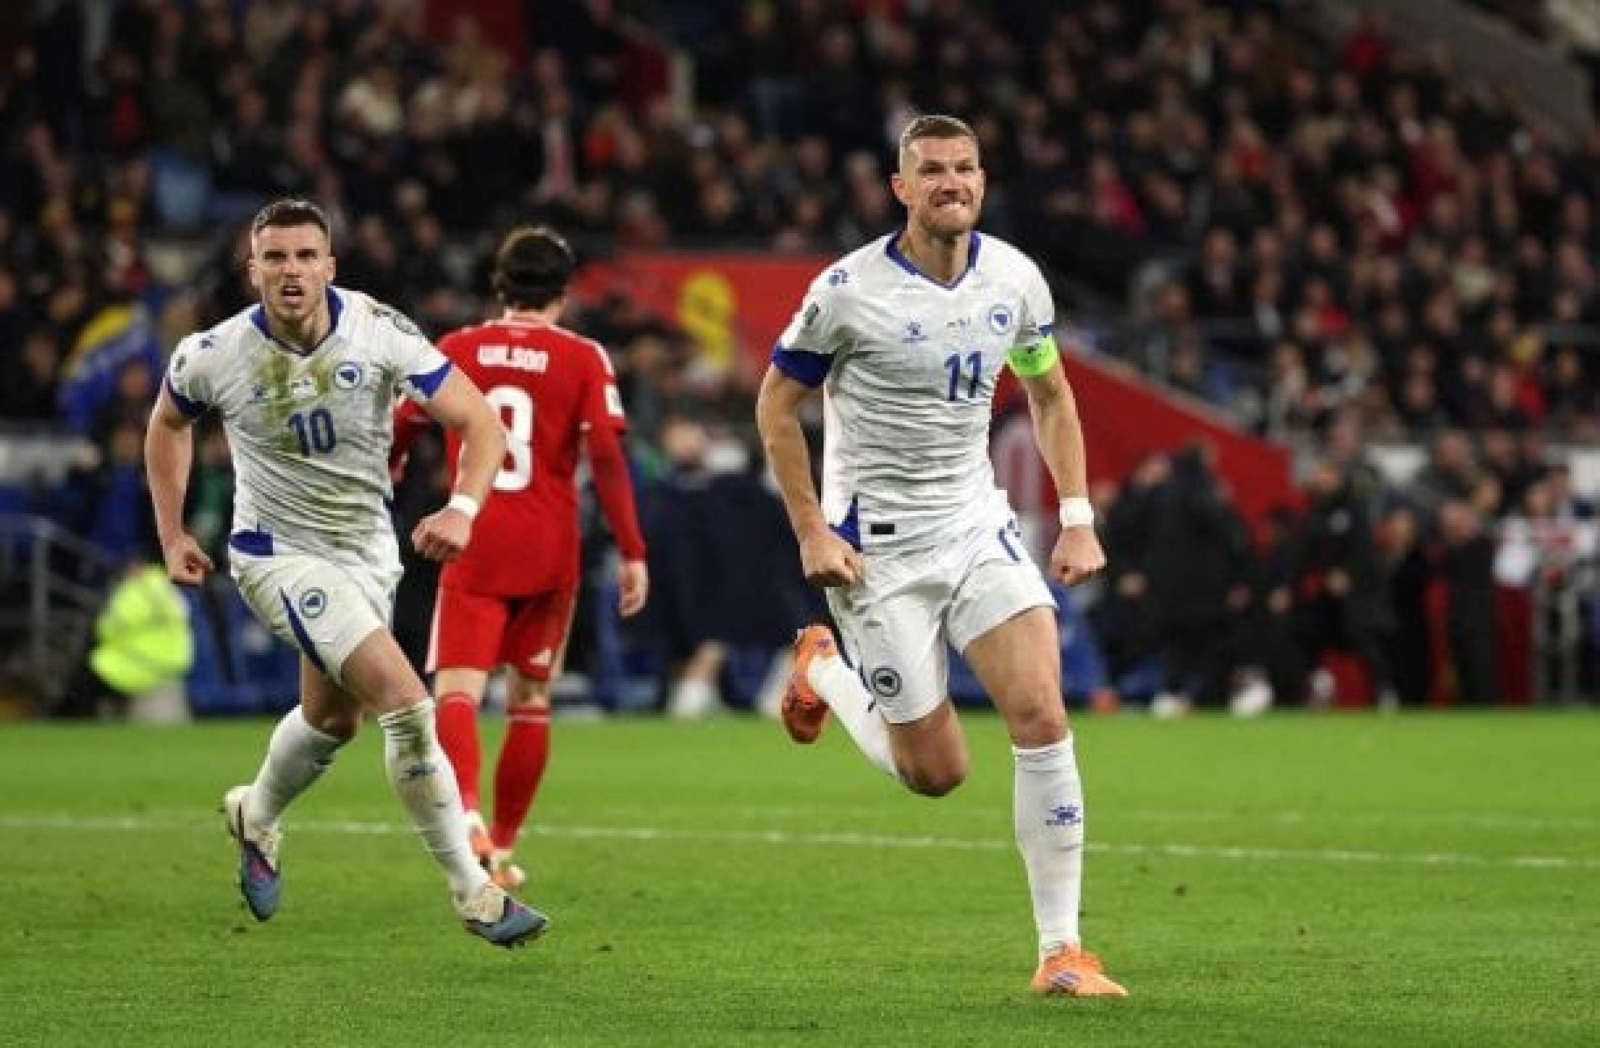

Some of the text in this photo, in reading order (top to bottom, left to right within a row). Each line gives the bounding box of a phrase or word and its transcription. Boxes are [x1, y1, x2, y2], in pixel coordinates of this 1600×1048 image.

[477, 344, 548, 372] WILSON
[944, 351, 981, 401] 11
[286, 408, 336, 458] 10
[484, 385, 533, 491] 8
